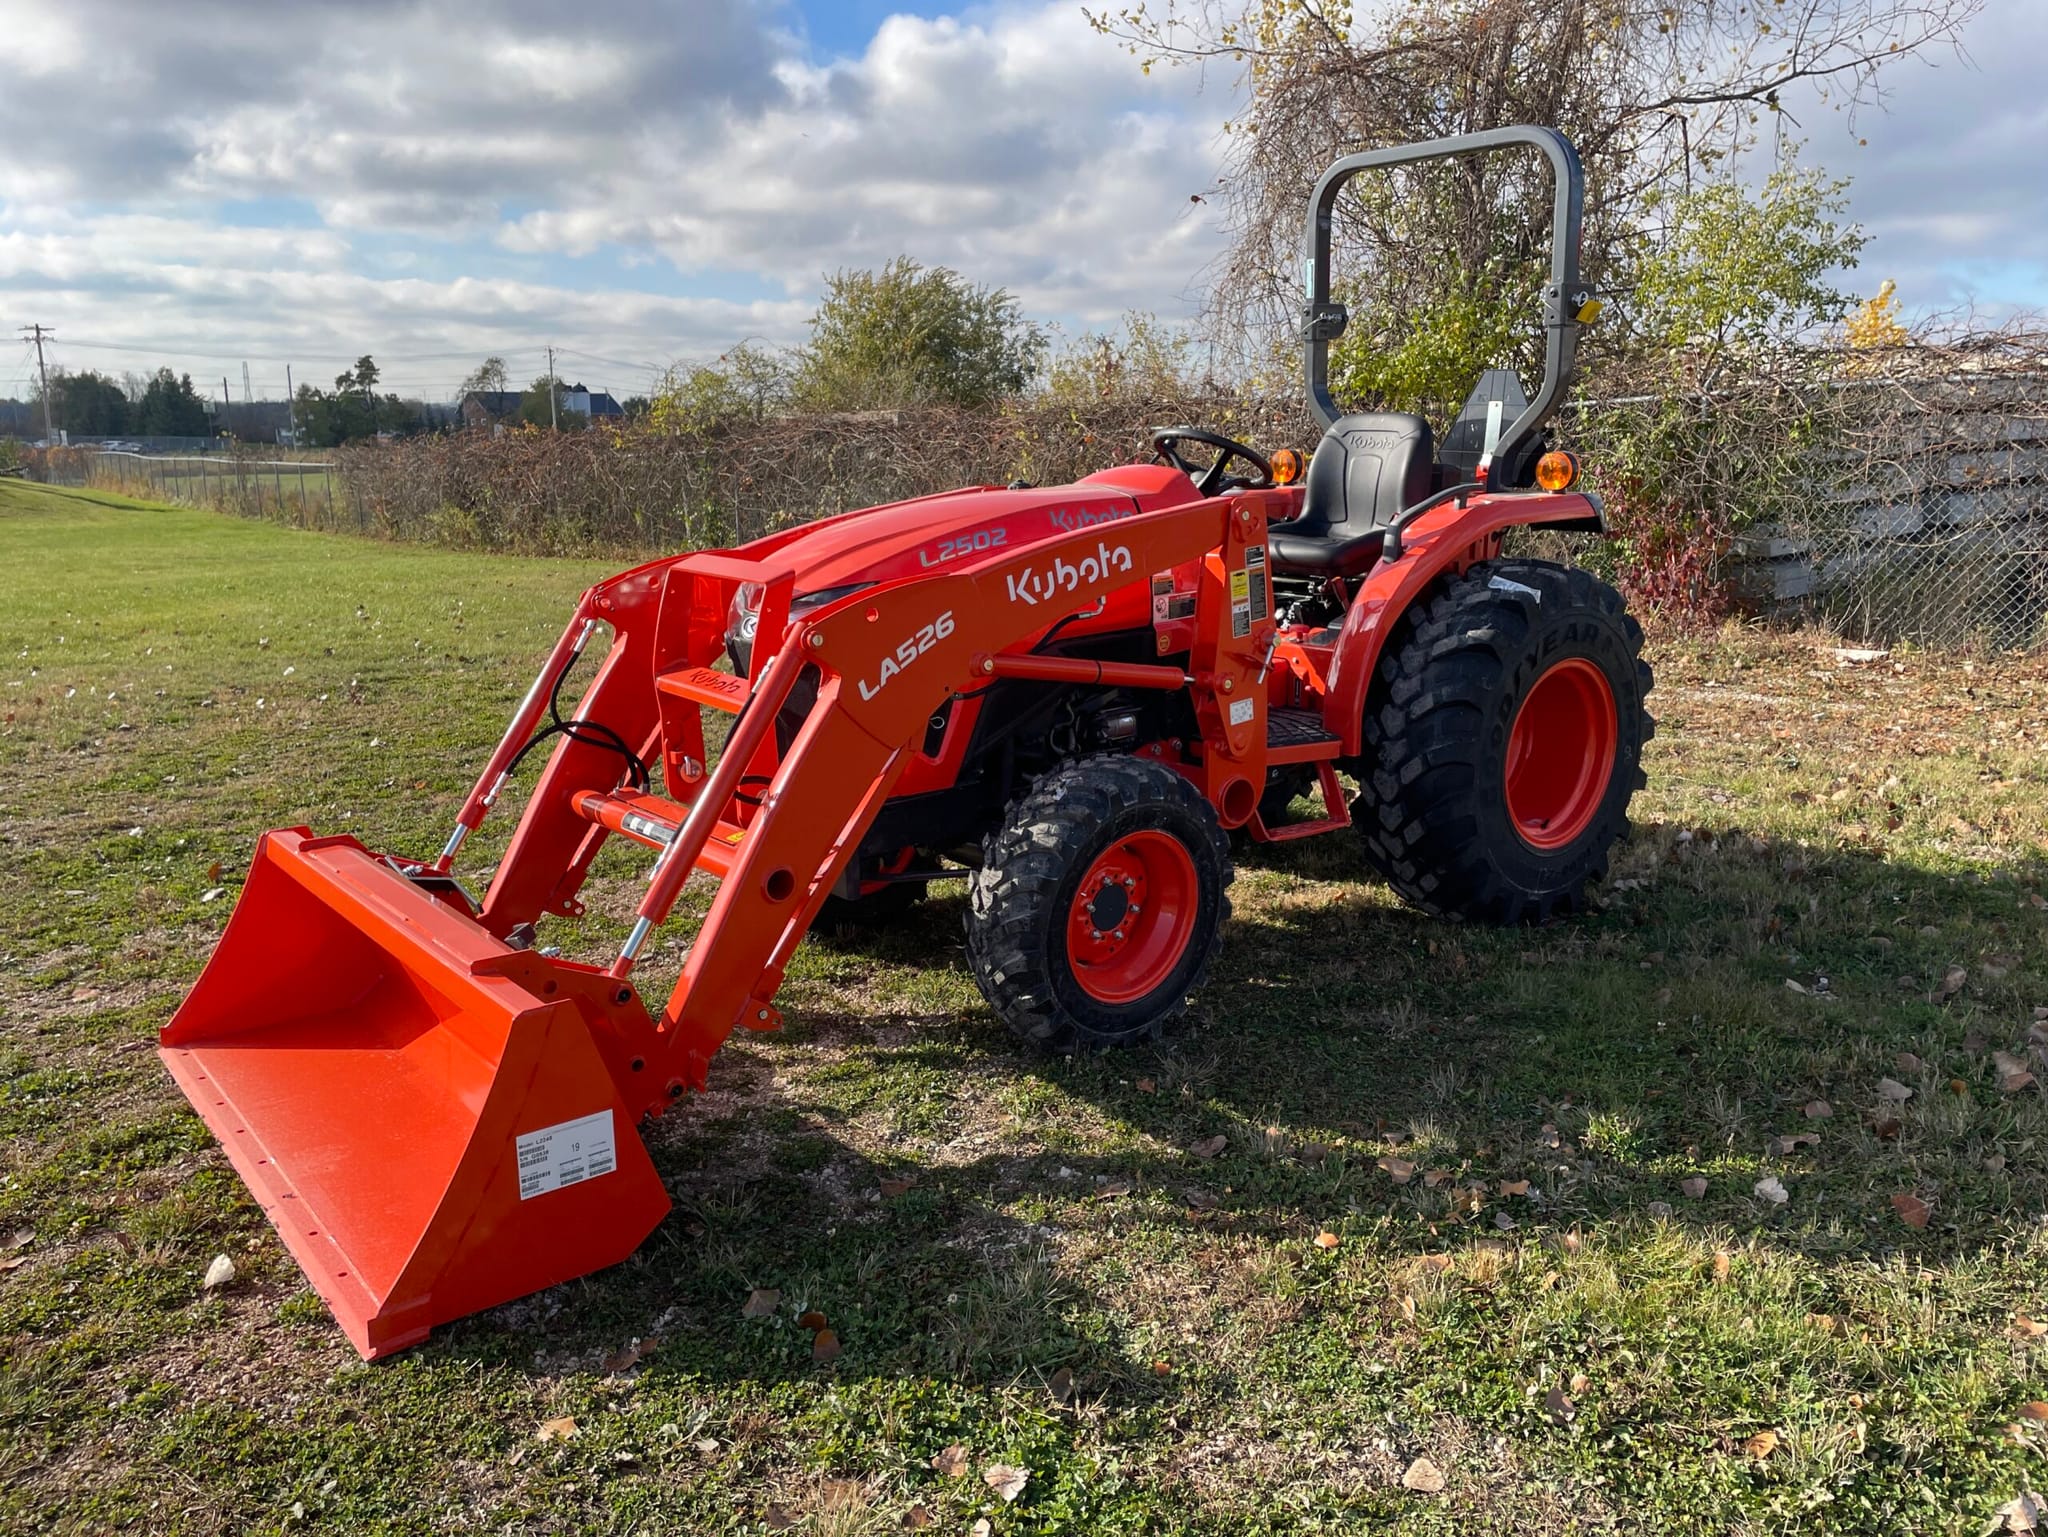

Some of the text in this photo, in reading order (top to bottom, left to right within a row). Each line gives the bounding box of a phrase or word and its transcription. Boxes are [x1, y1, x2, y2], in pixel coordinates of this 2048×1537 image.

[919, 527, 1008, 568] L2502
[1006, 542, 1133, 605] Kubota
[689, 670, 741, 693] Kubota
[857, 610, 955, 701] LA526
